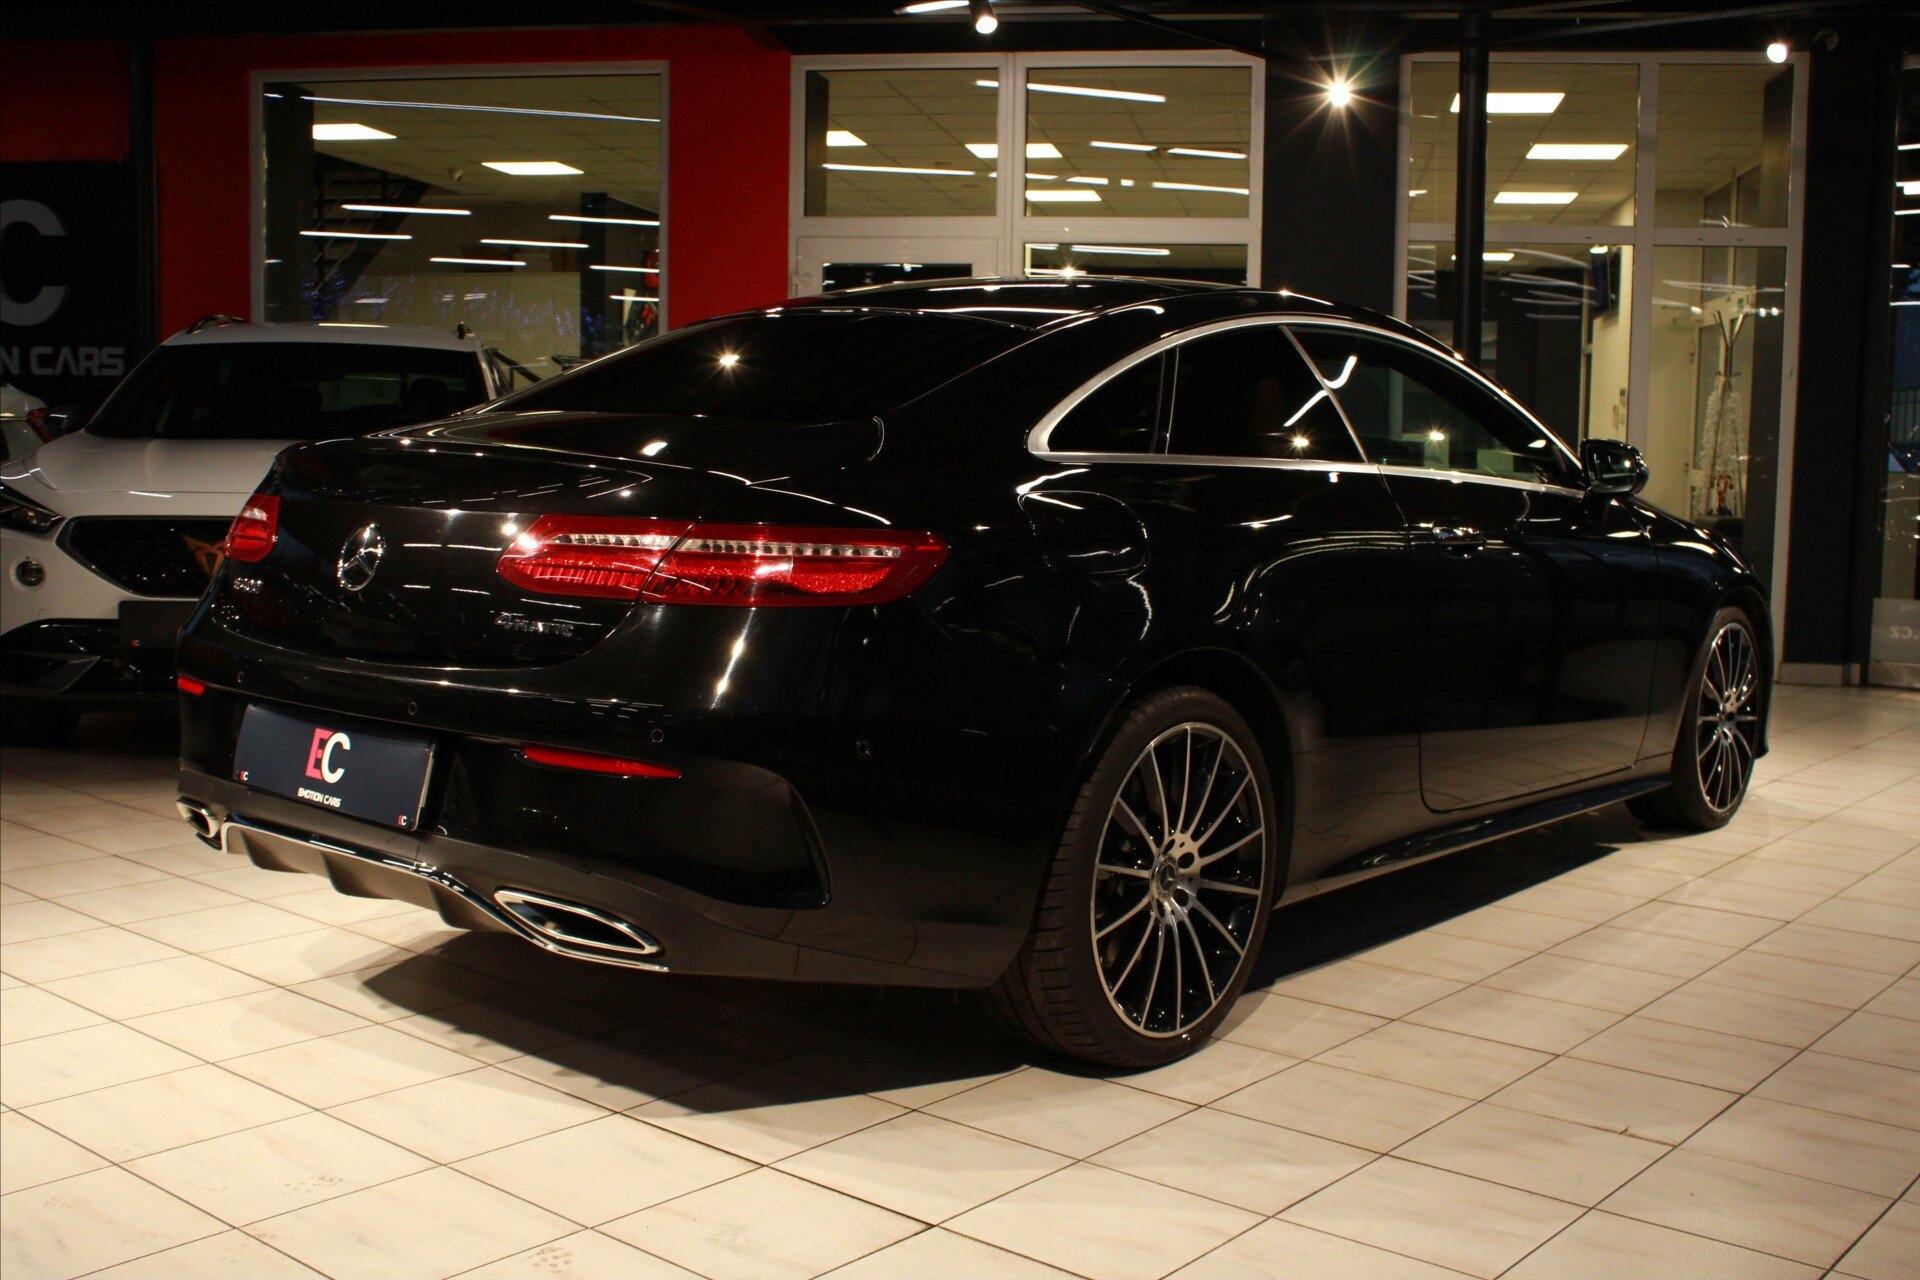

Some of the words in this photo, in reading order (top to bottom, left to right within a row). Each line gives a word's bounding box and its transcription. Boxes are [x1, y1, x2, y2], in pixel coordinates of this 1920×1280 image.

[29, 346, 127, 376] CARS
[305, 727, 350, 783] EC
[297, 787, 324, 803] EMOTION
[324, 794, 341, 808] CARS
